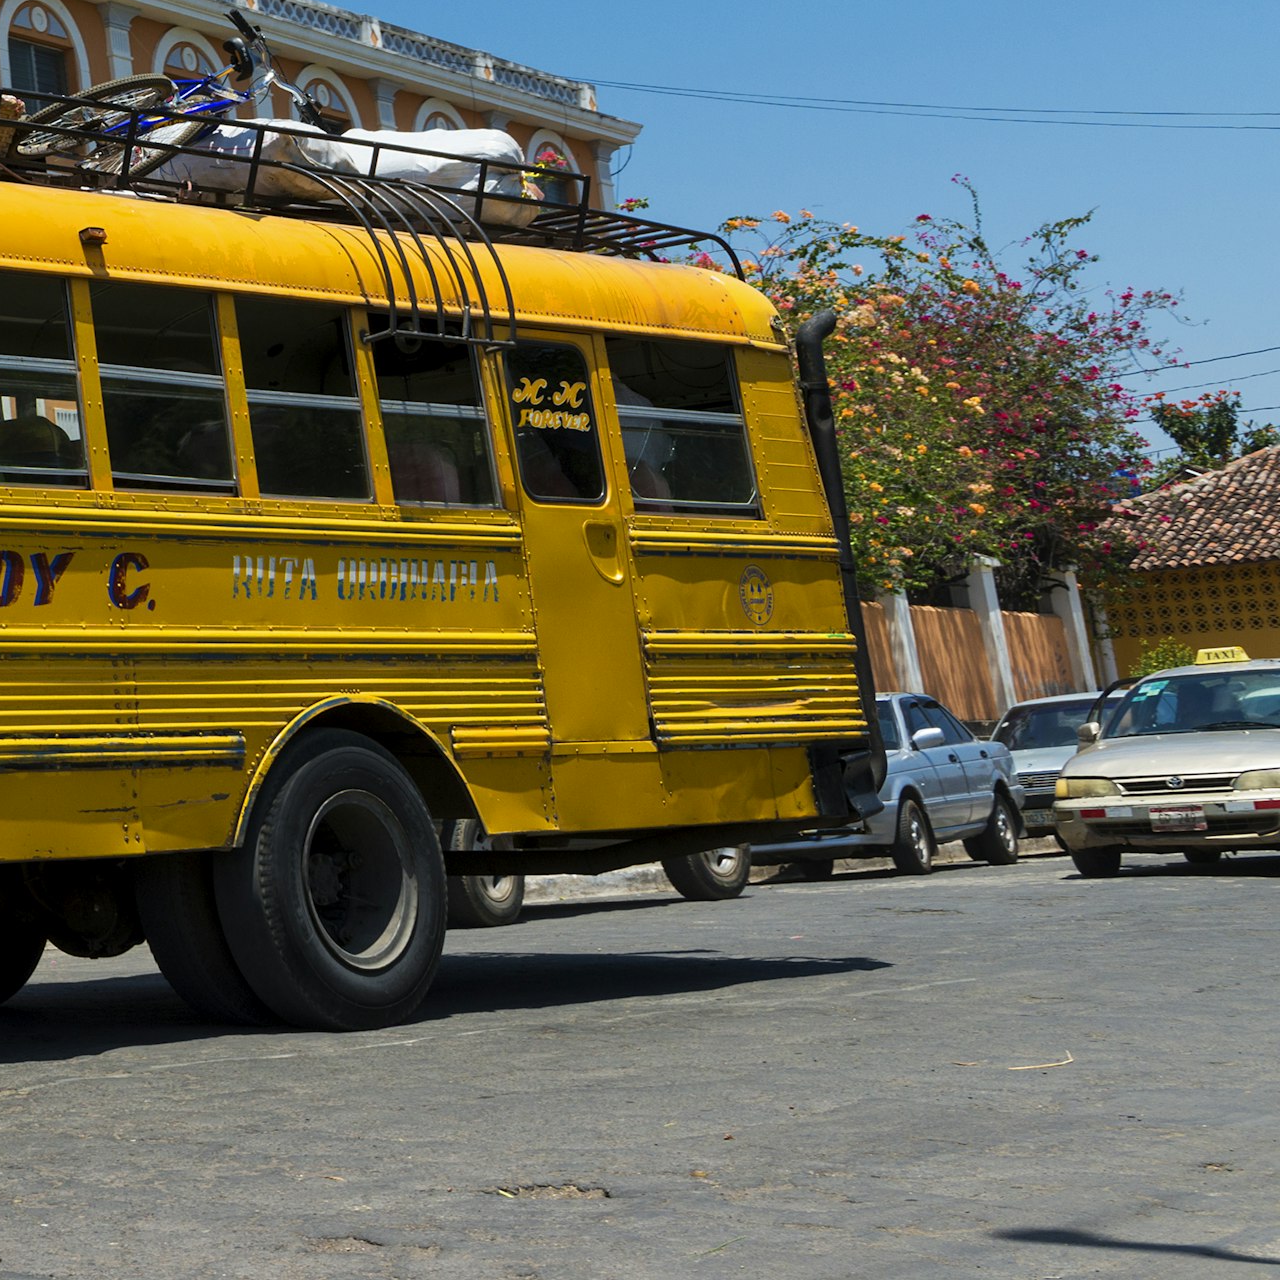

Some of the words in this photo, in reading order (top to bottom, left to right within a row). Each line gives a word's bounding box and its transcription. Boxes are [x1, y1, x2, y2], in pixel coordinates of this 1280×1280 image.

[517, 408, 592, 433] FOREVER
[232, 554, 318, 601] RUTA
[1203, 648, 1237, 661] TAXI
